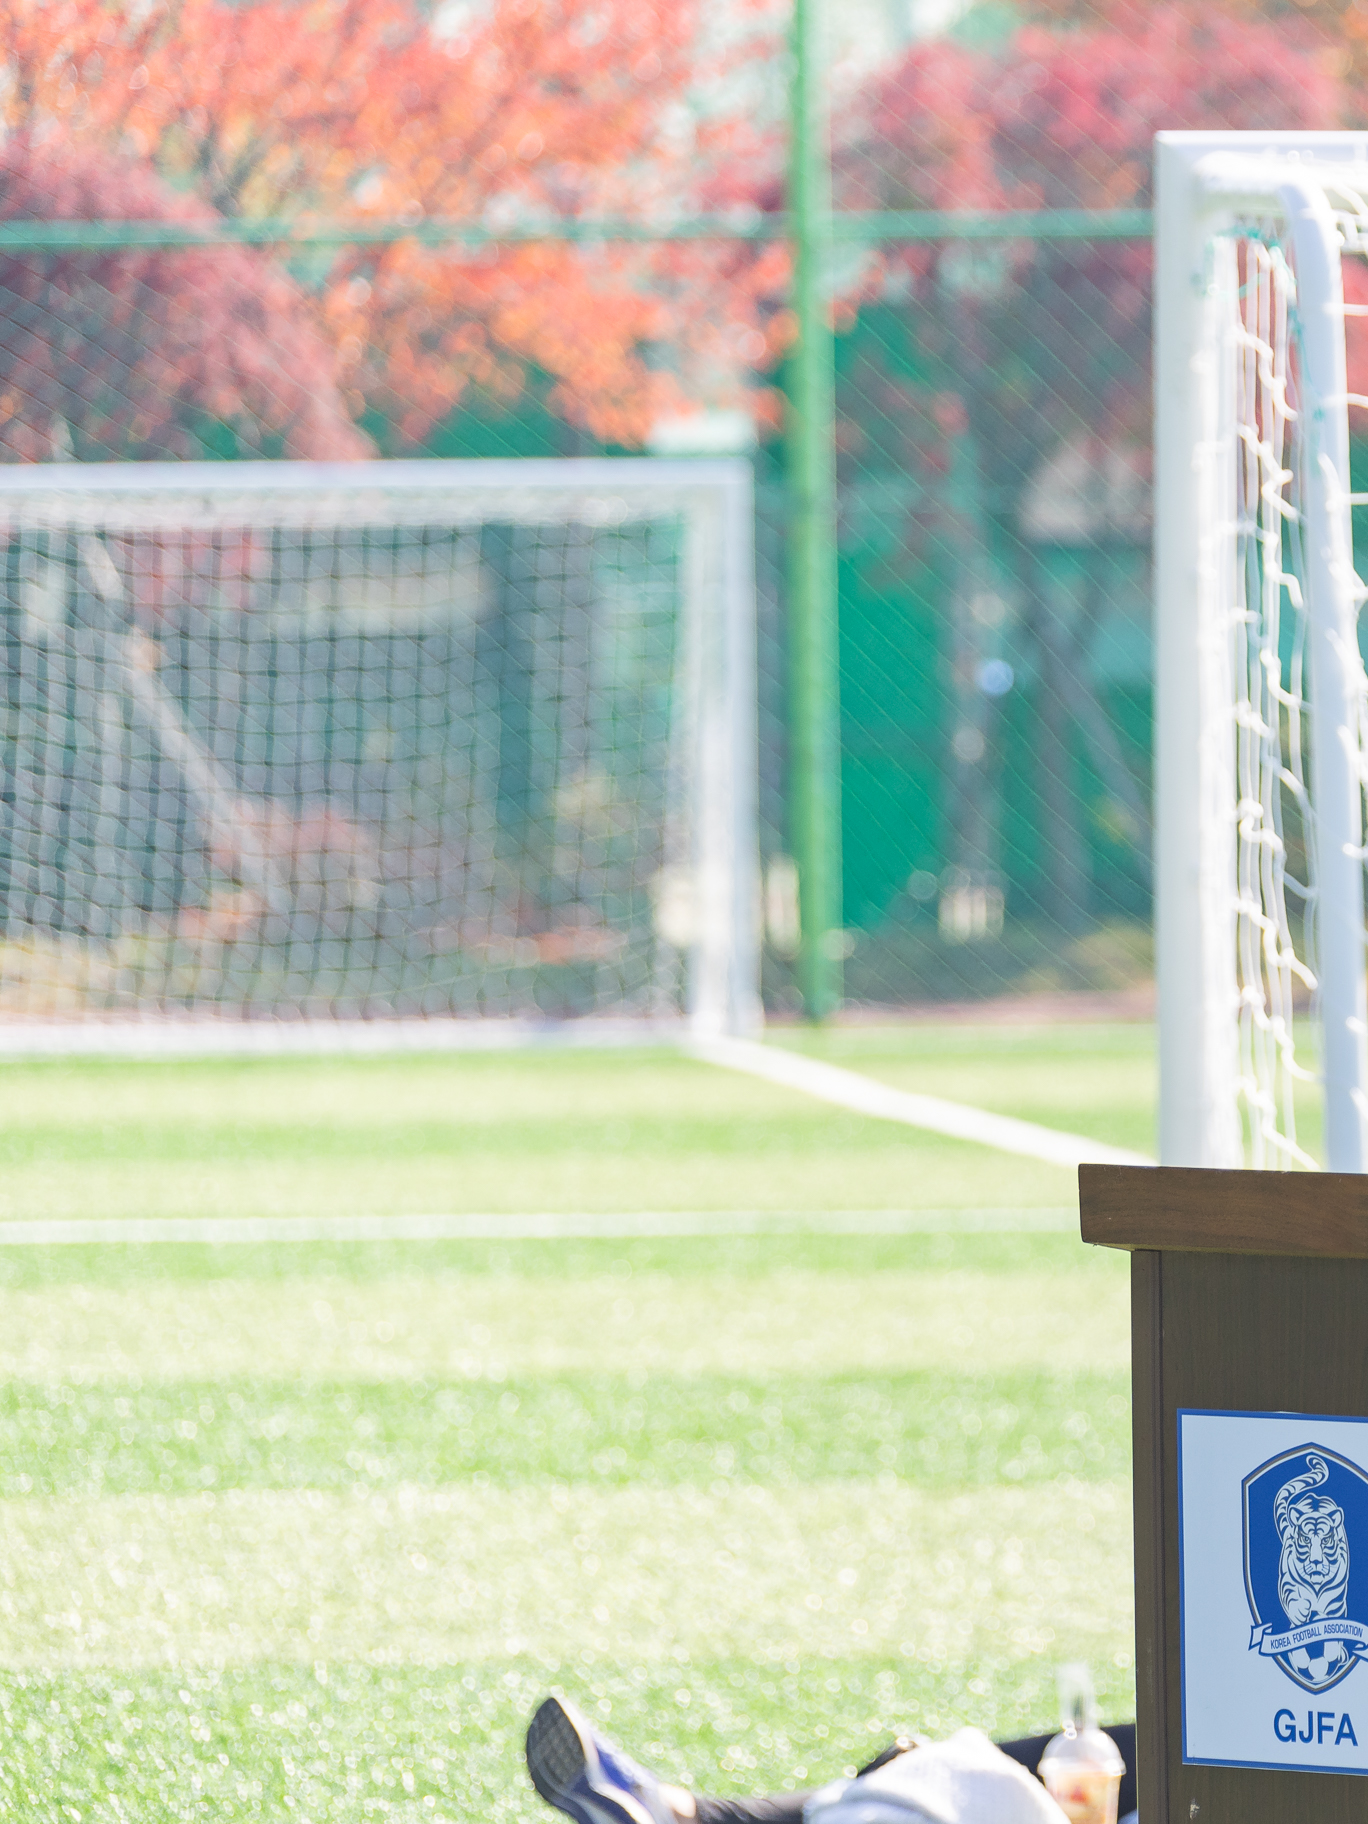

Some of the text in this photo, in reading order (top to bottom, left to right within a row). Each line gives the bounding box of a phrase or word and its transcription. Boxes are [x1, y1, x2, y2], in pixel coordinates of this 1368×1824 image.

[1270, 1623, 1364, 1650] KOREA FOOTBALL ASSOCIATION
[1273, 1708, 1359, 1747] GJFA
